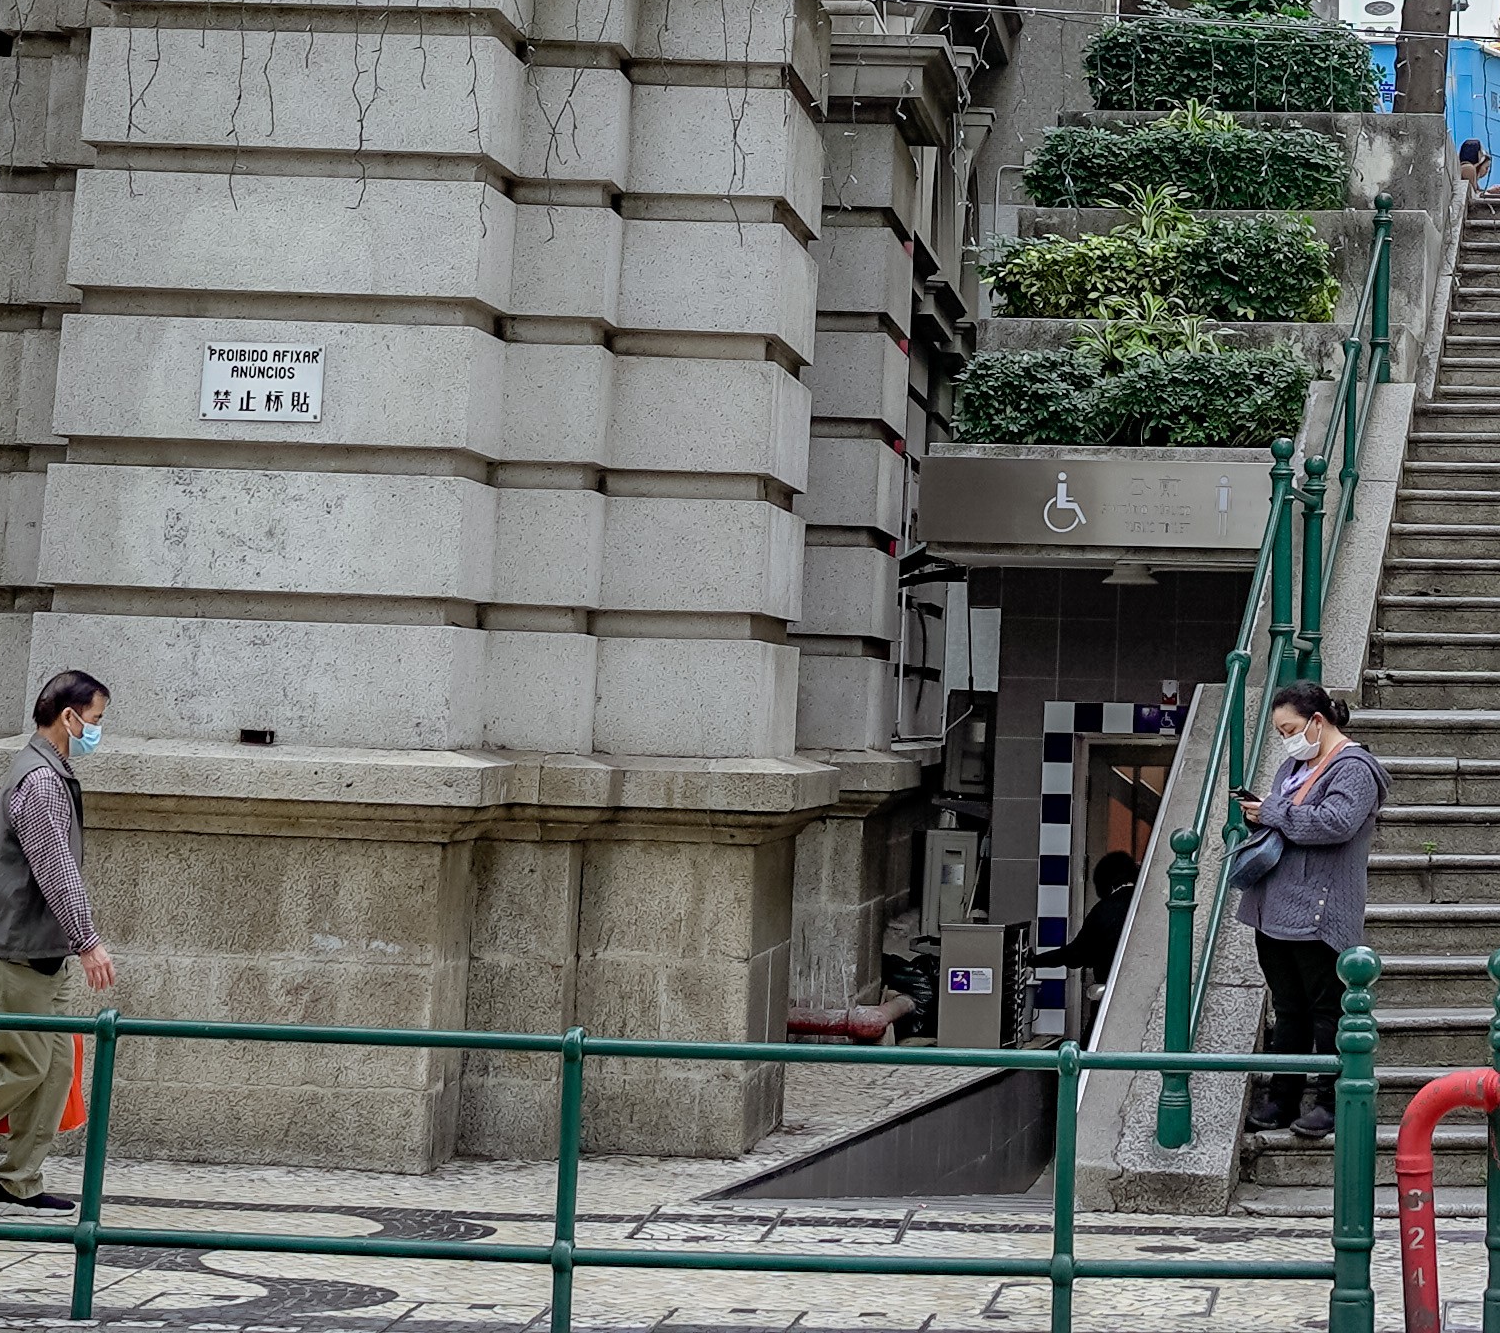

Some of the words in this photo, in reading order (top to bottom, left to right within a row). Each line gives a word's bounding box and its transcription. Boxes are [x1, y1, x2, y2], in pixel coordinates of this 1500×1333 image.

[209, 348, 268, 363] PROIBIDO
[272, 350, 320, 364] AFIXAR
[230, 363, 295, 380] ANÚNCIOS
